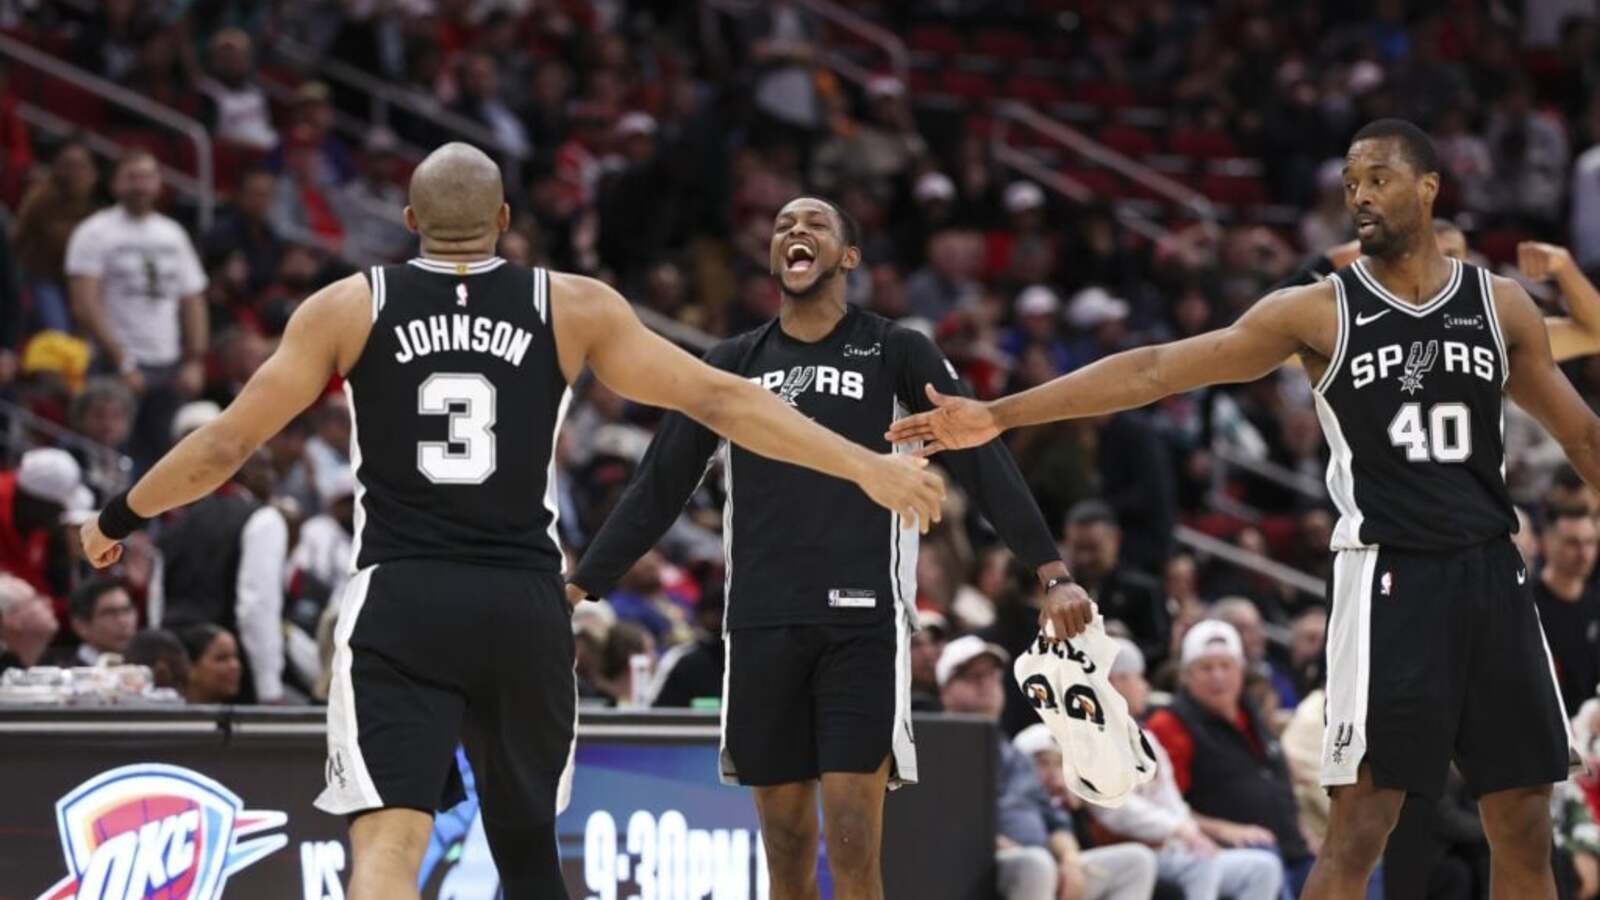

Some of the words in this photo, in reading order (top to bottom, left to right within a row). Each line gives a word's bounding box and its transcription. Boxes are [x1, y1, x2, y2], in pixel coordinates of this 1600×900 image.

[394, 314, 533, 367] JOHNSON
[1351, 340, 1495, 396] SPURS
[417, 372, 497, 484] 3
[1388, 402, 1472, 463] 40
